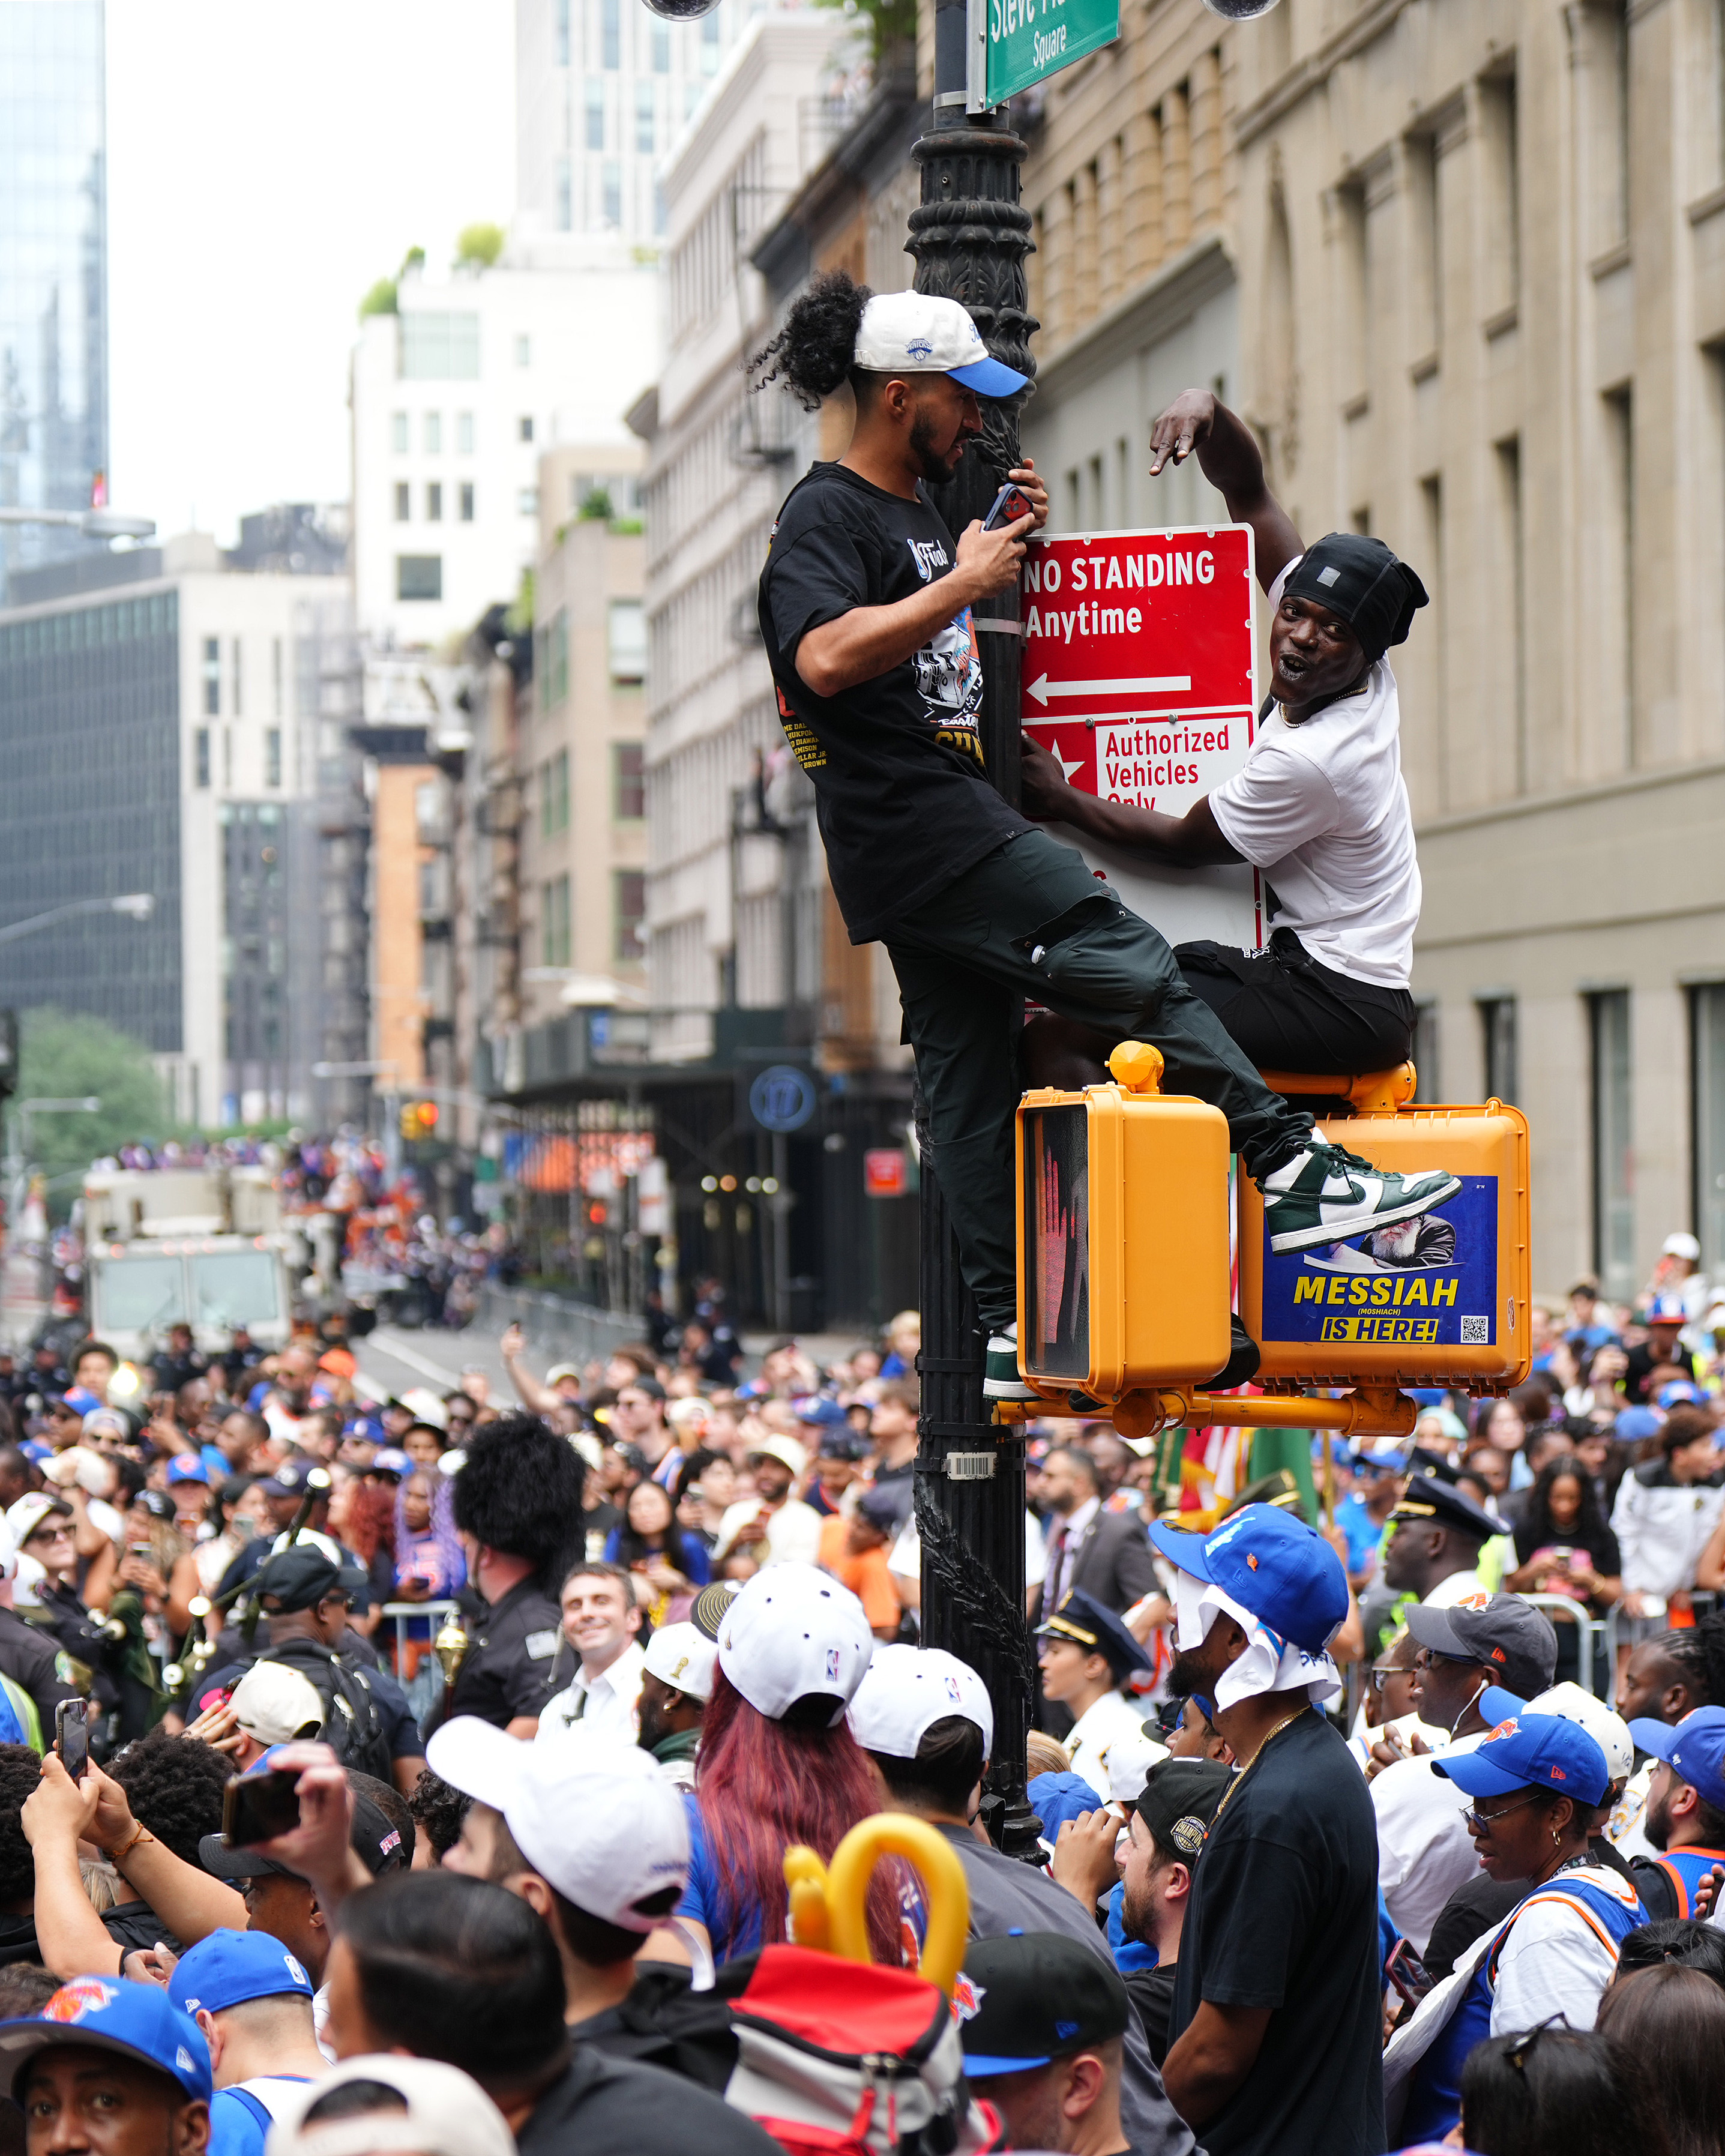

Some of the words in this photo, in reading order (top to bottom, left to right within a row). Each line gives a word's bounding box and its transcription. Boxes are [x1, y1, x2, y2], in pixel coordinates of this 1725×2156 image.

[1033, 23, 1067, 71] Square
[1024, 559, 1062, 594] NO
[1071, 550, 1215, 591] STANDING
[1025, 600, 1143, 645] Anytime
[1105, 724, 1230, 758] Authorized
[804, 759, 826, 768] BROWN
[1105, 758, 1199, 789] Vehicles
[1293, 1277, 1458, 1306] MESSIAH
[1357, 1307, 1401, 1316] (MOSHIACH)
[1325, 1319, 1348, 1339] IS
[1357, 1320, 1437, 1341] HERE!
[1175, 1822, 1203, 1850] CHAMPION
